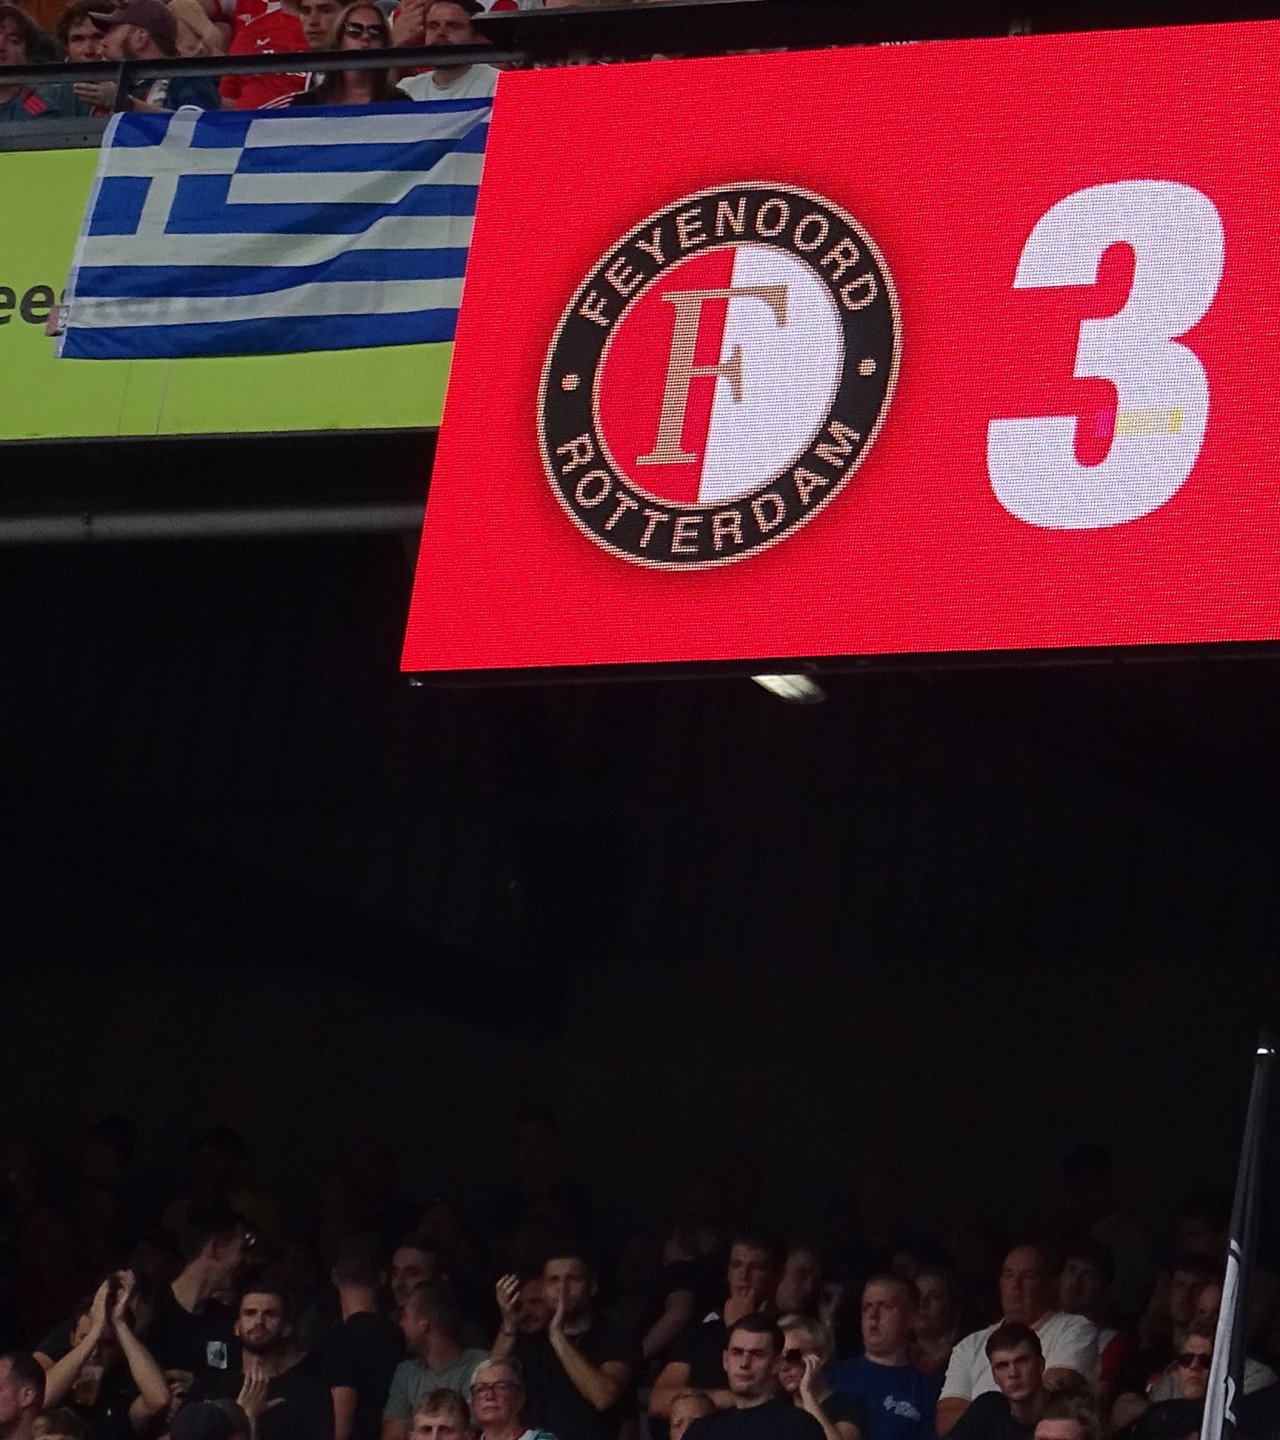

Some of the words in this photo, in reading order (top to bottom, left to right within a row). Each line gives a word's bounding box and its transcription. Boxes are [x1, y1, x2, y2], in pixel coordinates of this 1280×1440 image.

[577, 196, 880, 327] FEYENOORD
[636, 284, 789, 466] F
[986, 178, 1227, 531] 3
[555, 419, 861, 555] ROTTERDAM
